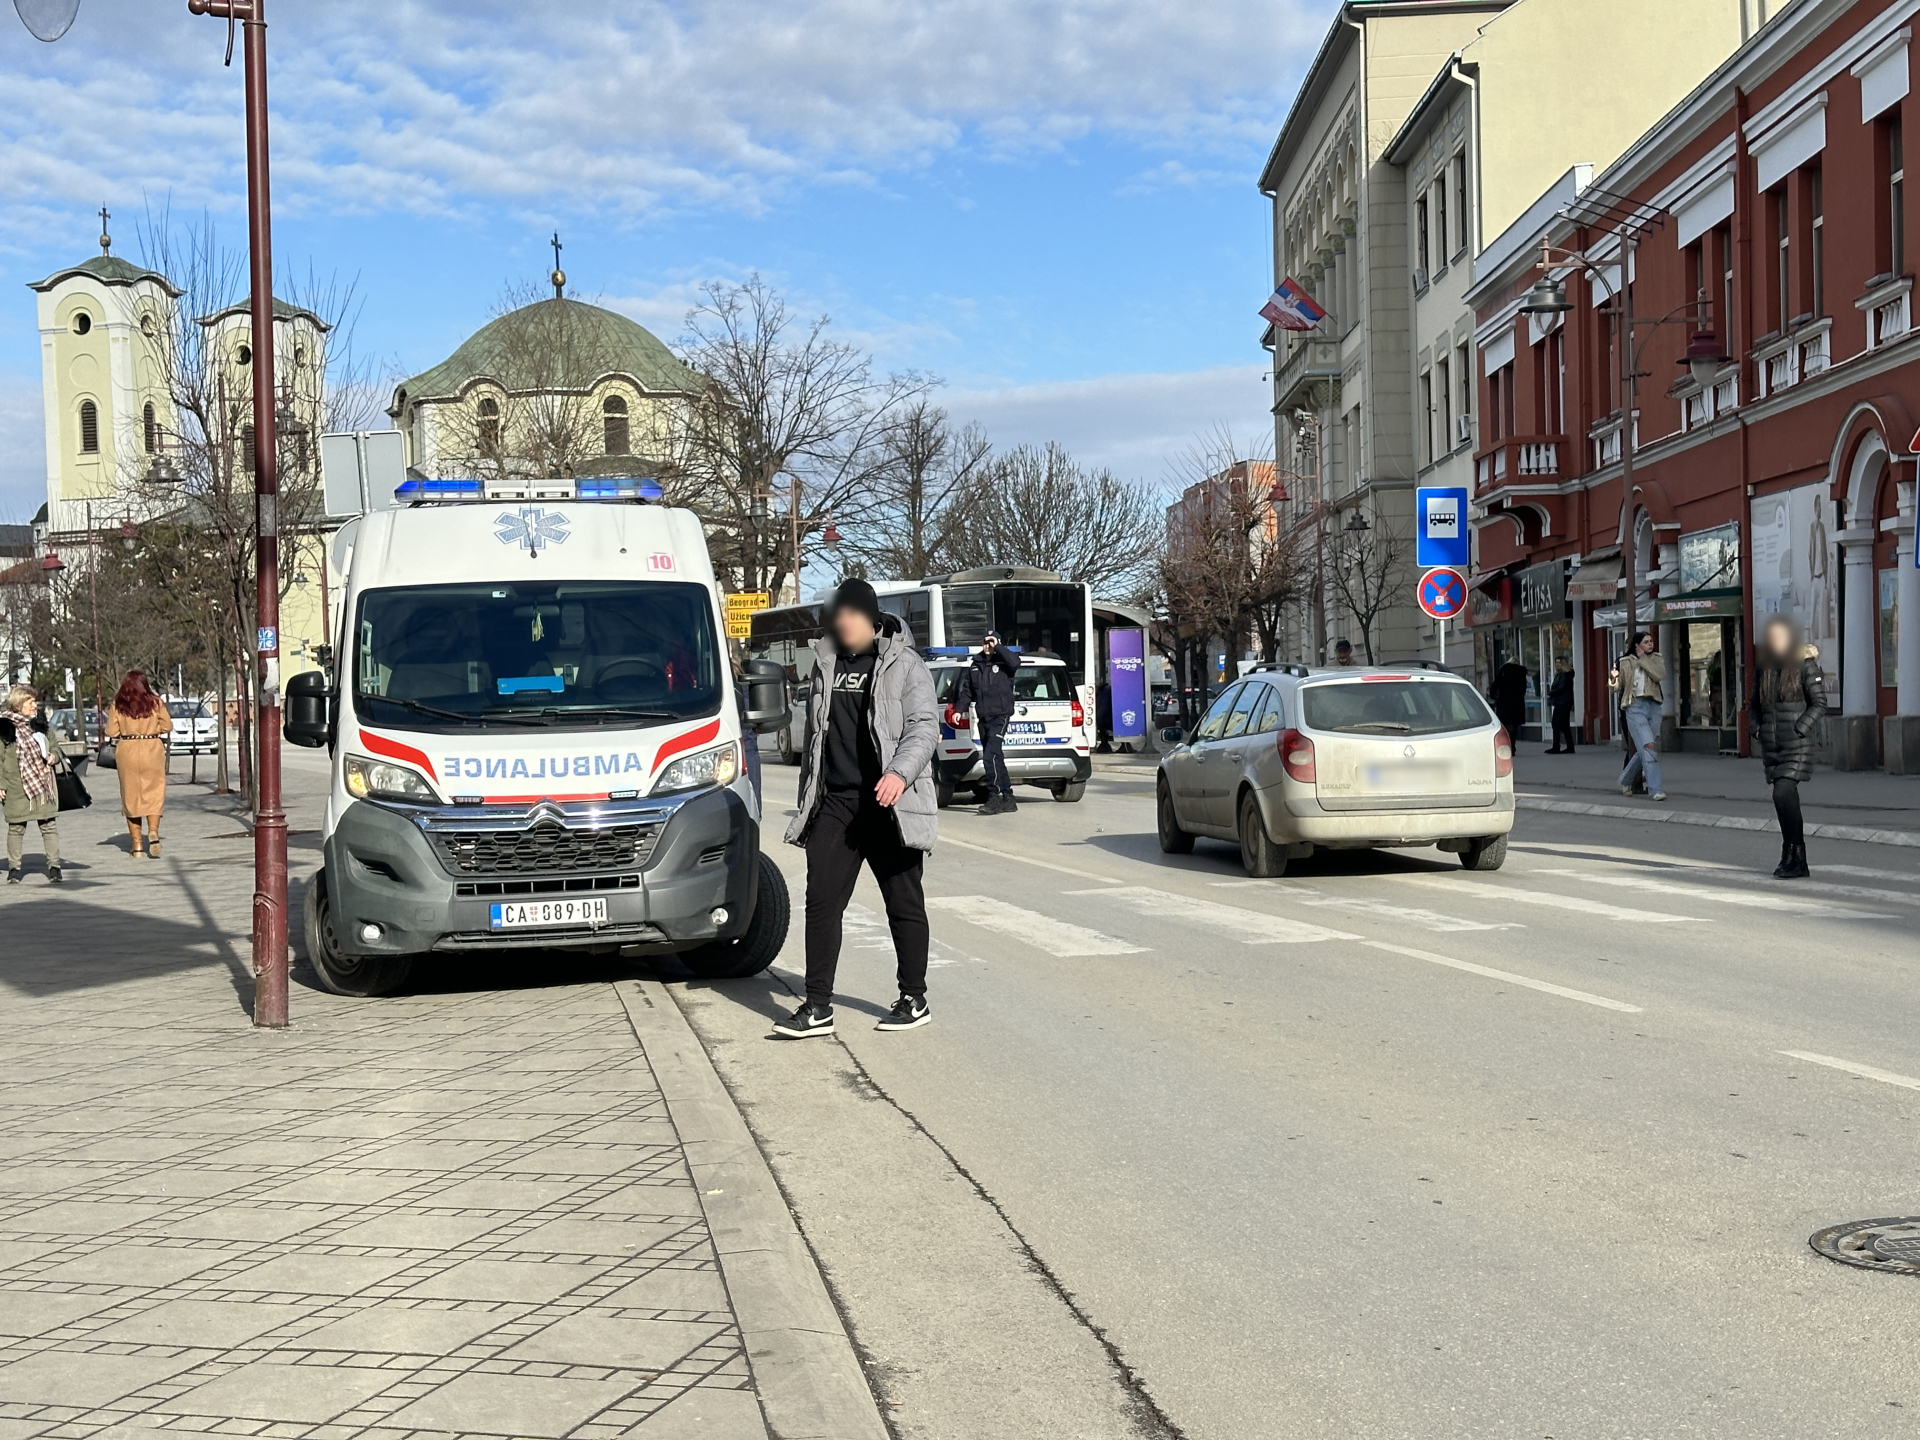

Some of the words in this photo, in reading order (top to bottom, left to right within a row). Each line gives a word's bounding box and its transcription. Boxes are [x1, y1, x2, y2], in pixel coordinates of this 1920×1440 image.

[649, 555, 672, 570] 10
[729, 598, 758, 607] Beograd
[1521, 573, 1552, 619] Elipsa
[730, 612, 750, 621] Užice
[505, 905, 528, 923] ČA
